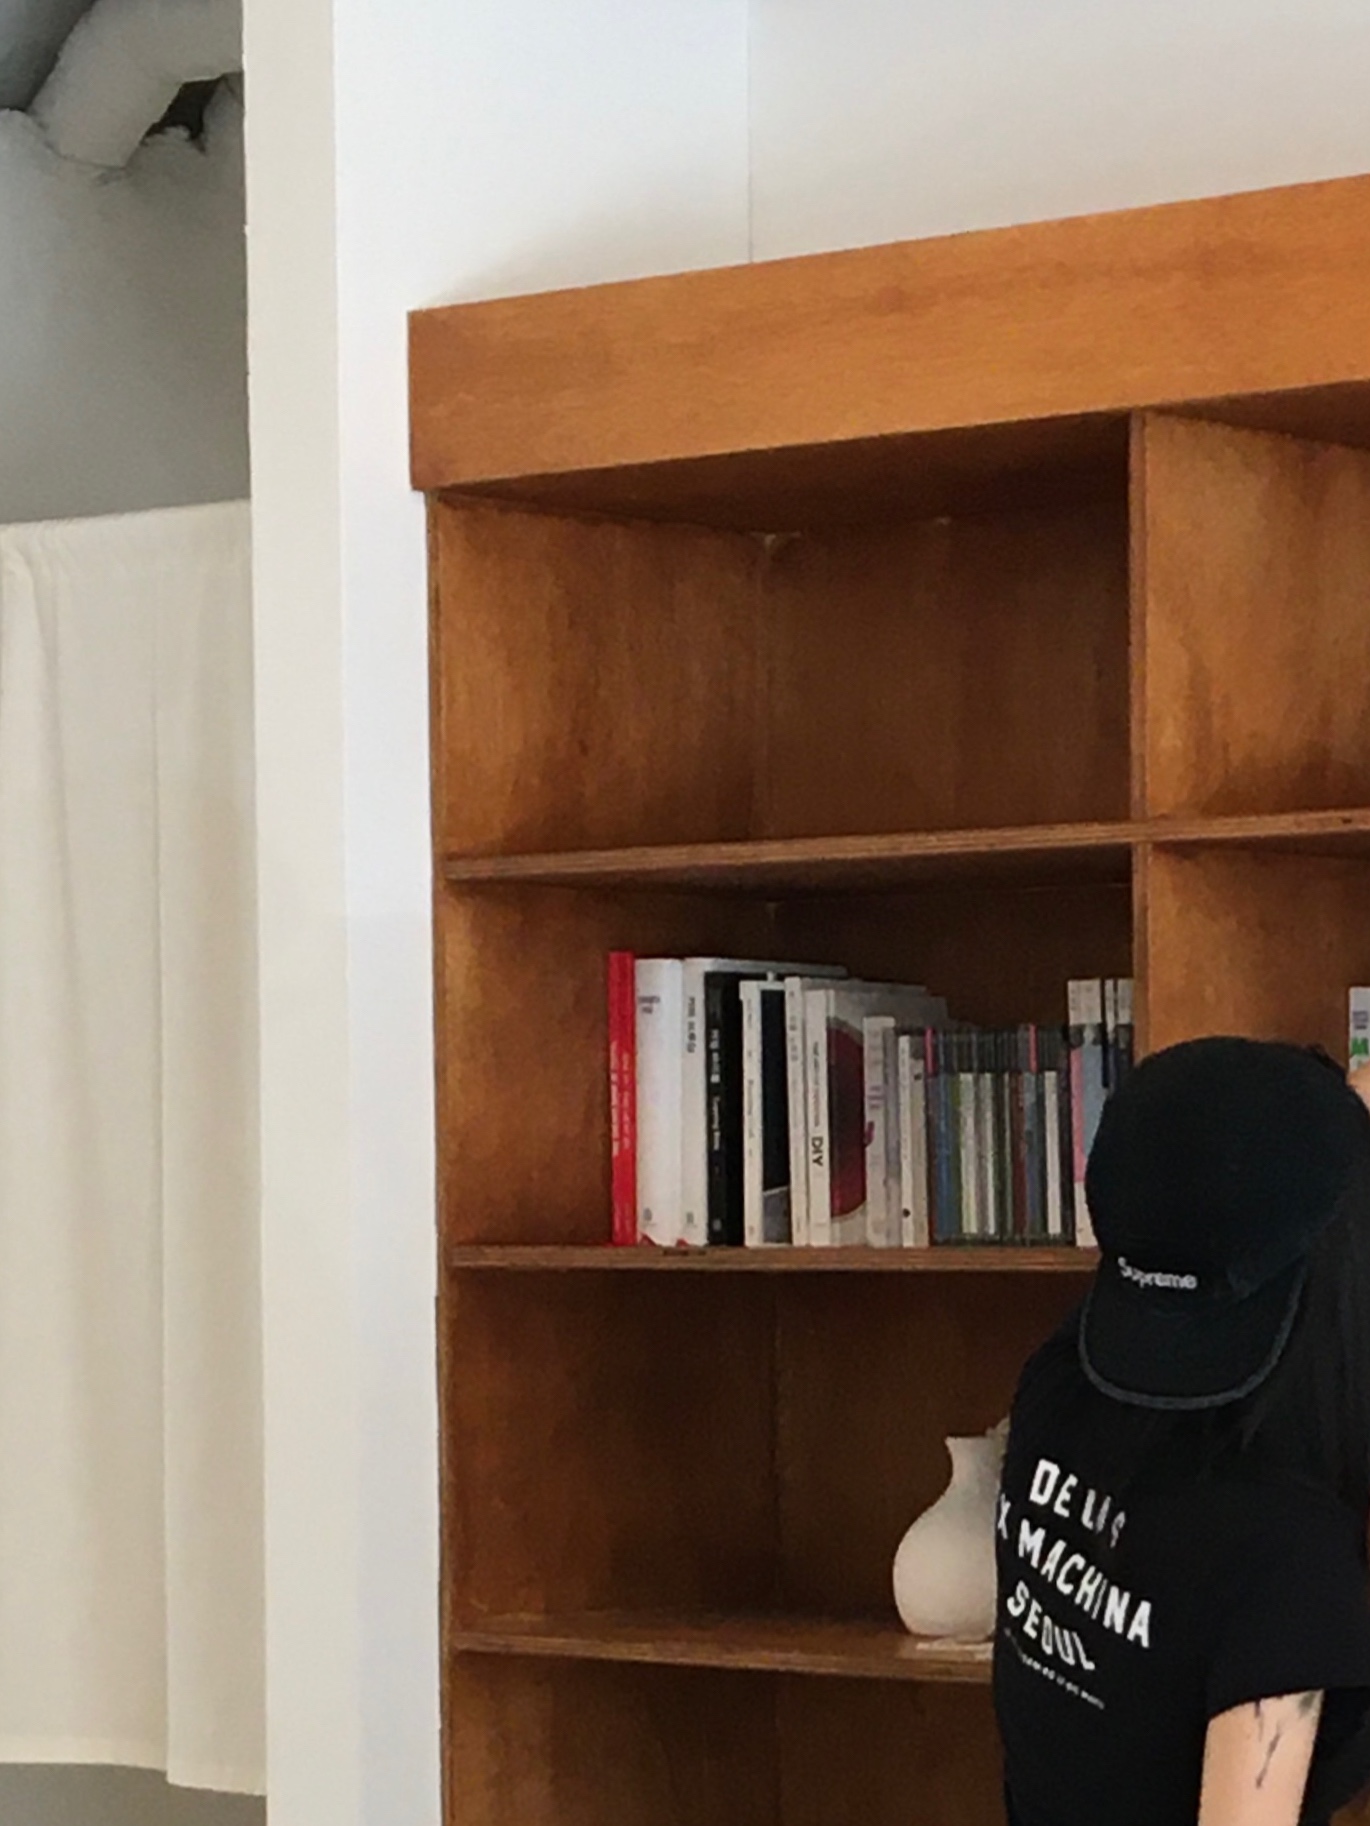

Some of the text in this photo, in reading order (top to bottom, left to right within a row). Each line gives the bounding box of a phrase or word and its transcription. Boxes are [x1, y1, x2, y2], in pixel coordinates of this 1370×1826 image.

[811, 1136, 824, 1167] DIY
[1117, 1256, 1198, 1289] Supreme
[1028, 1457, 1127, 1549] DEUS
[1005, 1579, 1096, 1671] SEOUL
[1017, 1517, 1152, 1649] MACHINA
